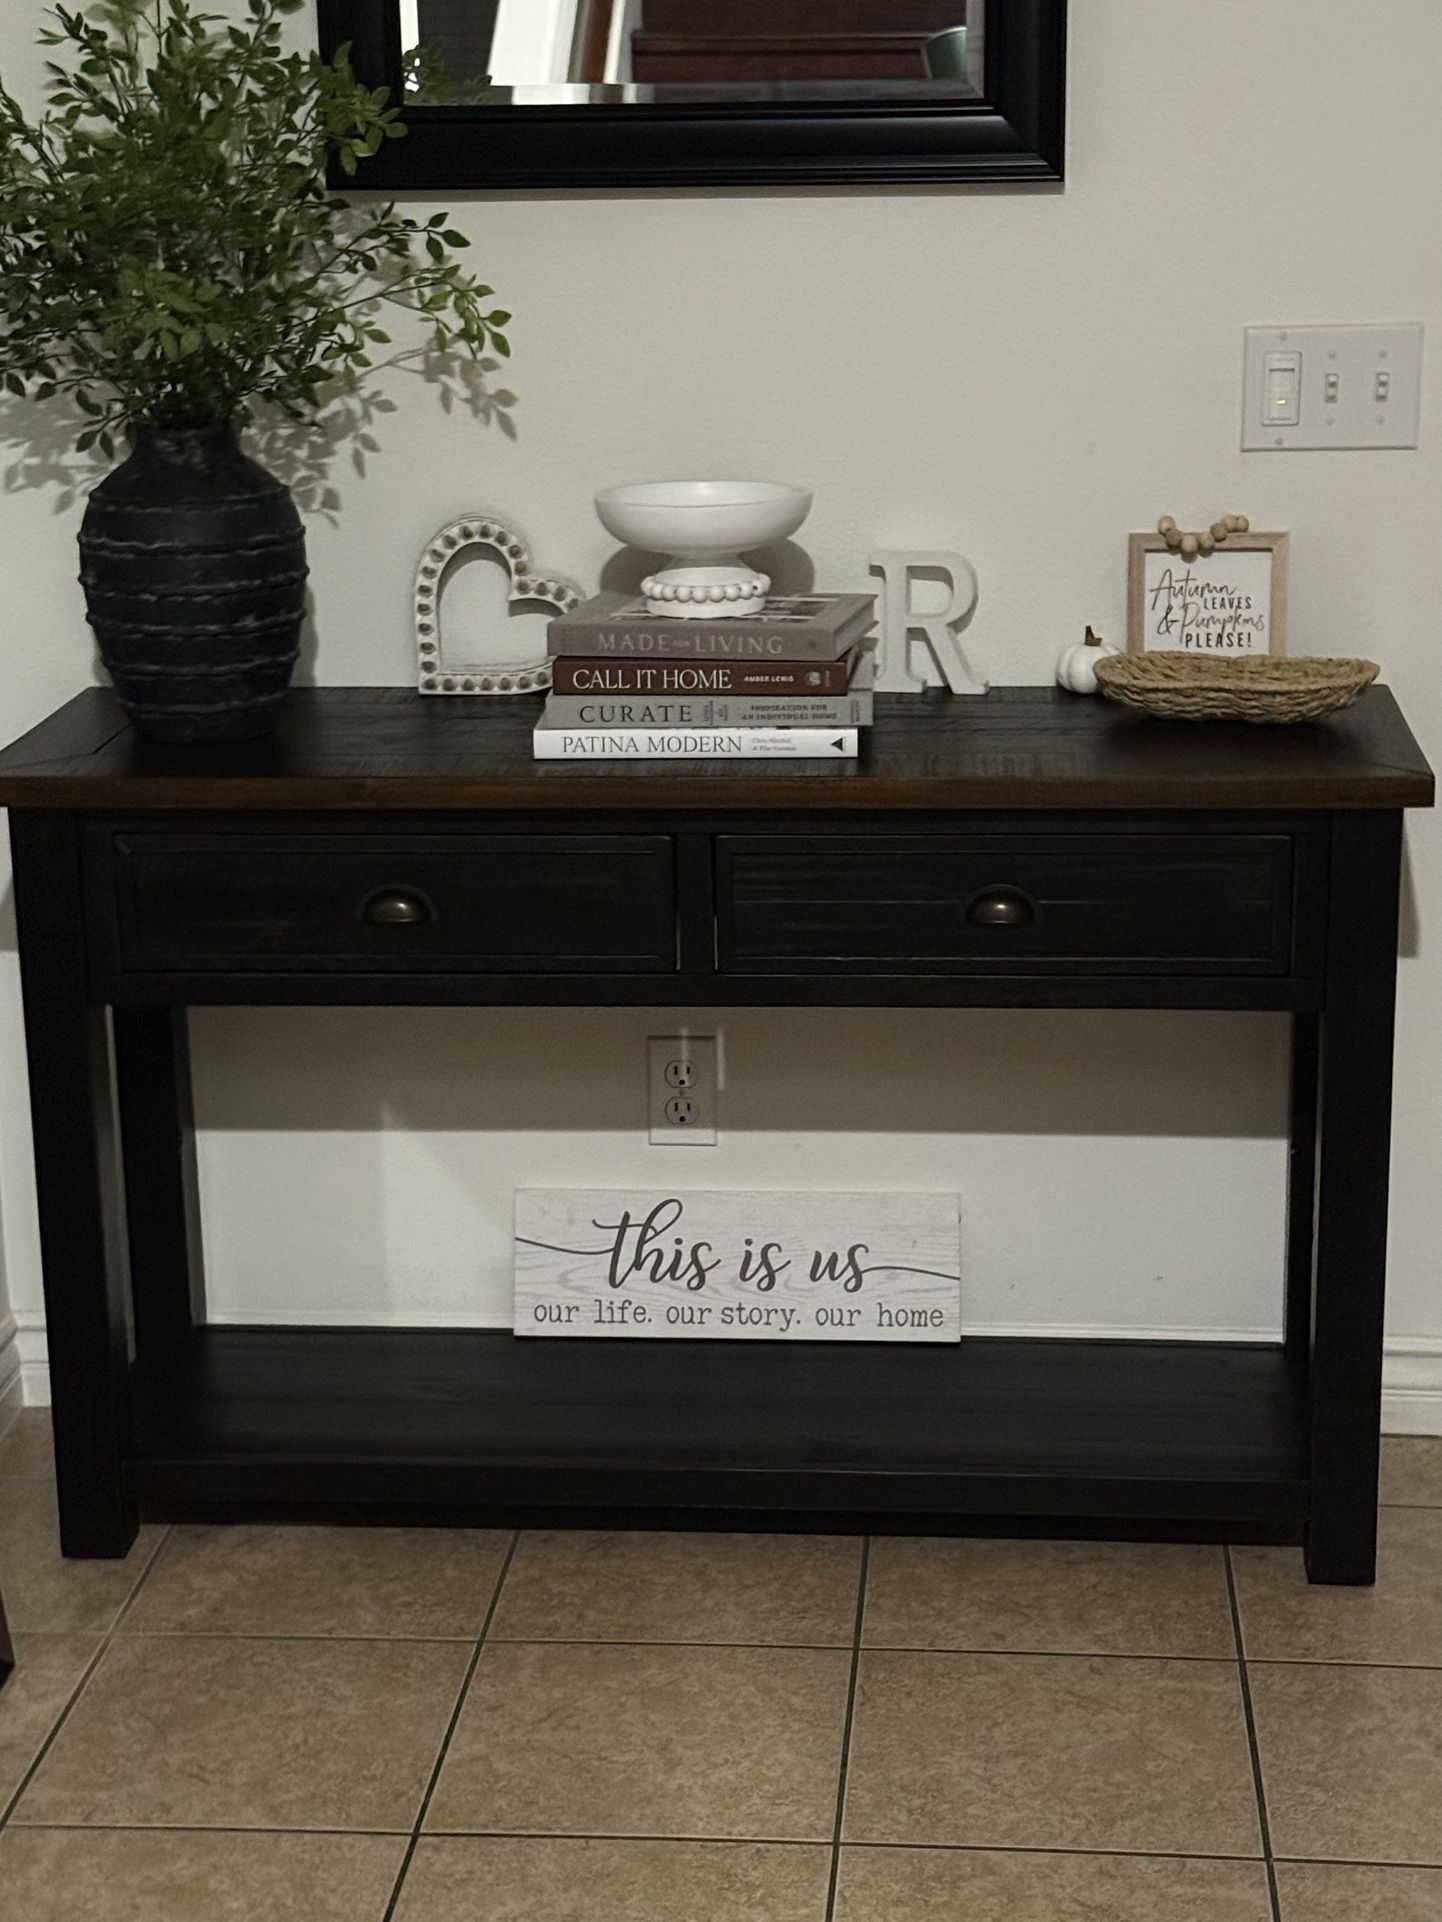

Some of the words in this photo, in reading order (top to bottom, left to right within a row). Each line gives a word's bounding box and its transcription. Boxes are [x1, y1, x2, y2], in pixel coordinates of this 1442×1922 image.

[1149, 569, 1236, 610] Autumn
[1203, 596, 1252, 610] LEAVES
[869, 550, 988, 695] R
[1157, 605, 1180, 635] &
[1179, 602, 1265, 643] Pumpkins
[597, 633, 670, 651] MADE
[696, 635, 783, 655] LIVING
[1185, 632, 1252, 648] PLEASE!
[572, 669, 631, 690] CALL
[636, 669, 657, 689] IT
[662, 669, 733, 690] HOME
[579, 705, 693, 723] CURATE
[562, 736, 640, 752] PATINA
[647, 736, 742, 753] MODERN
[592, 1198, 721, 1291] this
[738, 1238, 791, 1292] is
[809, 1243, 871, 1293] us
[533, 1305, 580, 1323] our
[593, 1300, 652, 1324] life.
[665, 1305, 711, 1325] our
[720, 1304, 801, 1332] story.
[815, 1306, 861, 1327] our
[876, 1303, 945, 1328] home
